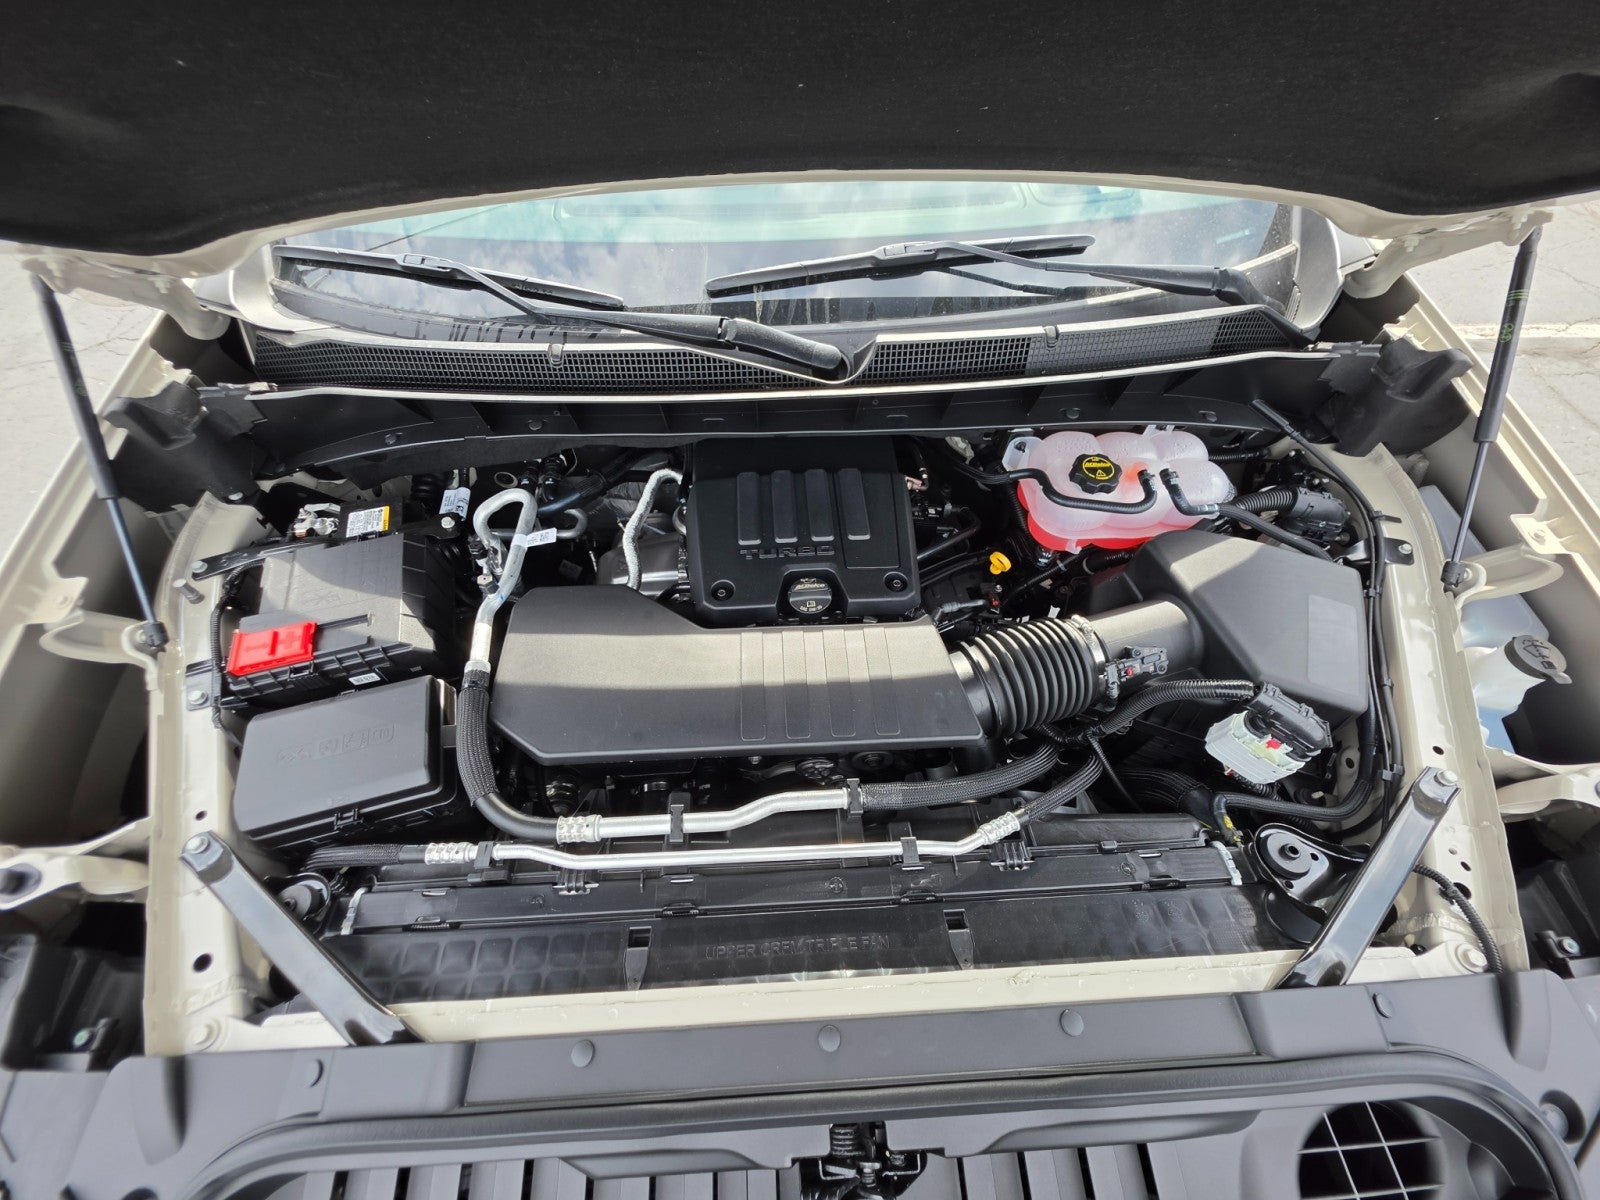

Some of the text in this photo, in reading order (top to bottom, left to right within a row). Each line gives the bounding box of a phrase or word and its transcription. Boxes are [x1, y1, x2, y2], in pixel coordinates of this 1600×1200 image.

[740, 545, 835, 560] TURBO
[705, 943, 757, 960] UPPER
[806, 936, 858, 953] TRIPLE
[862, 935, 890, 950] FAN
